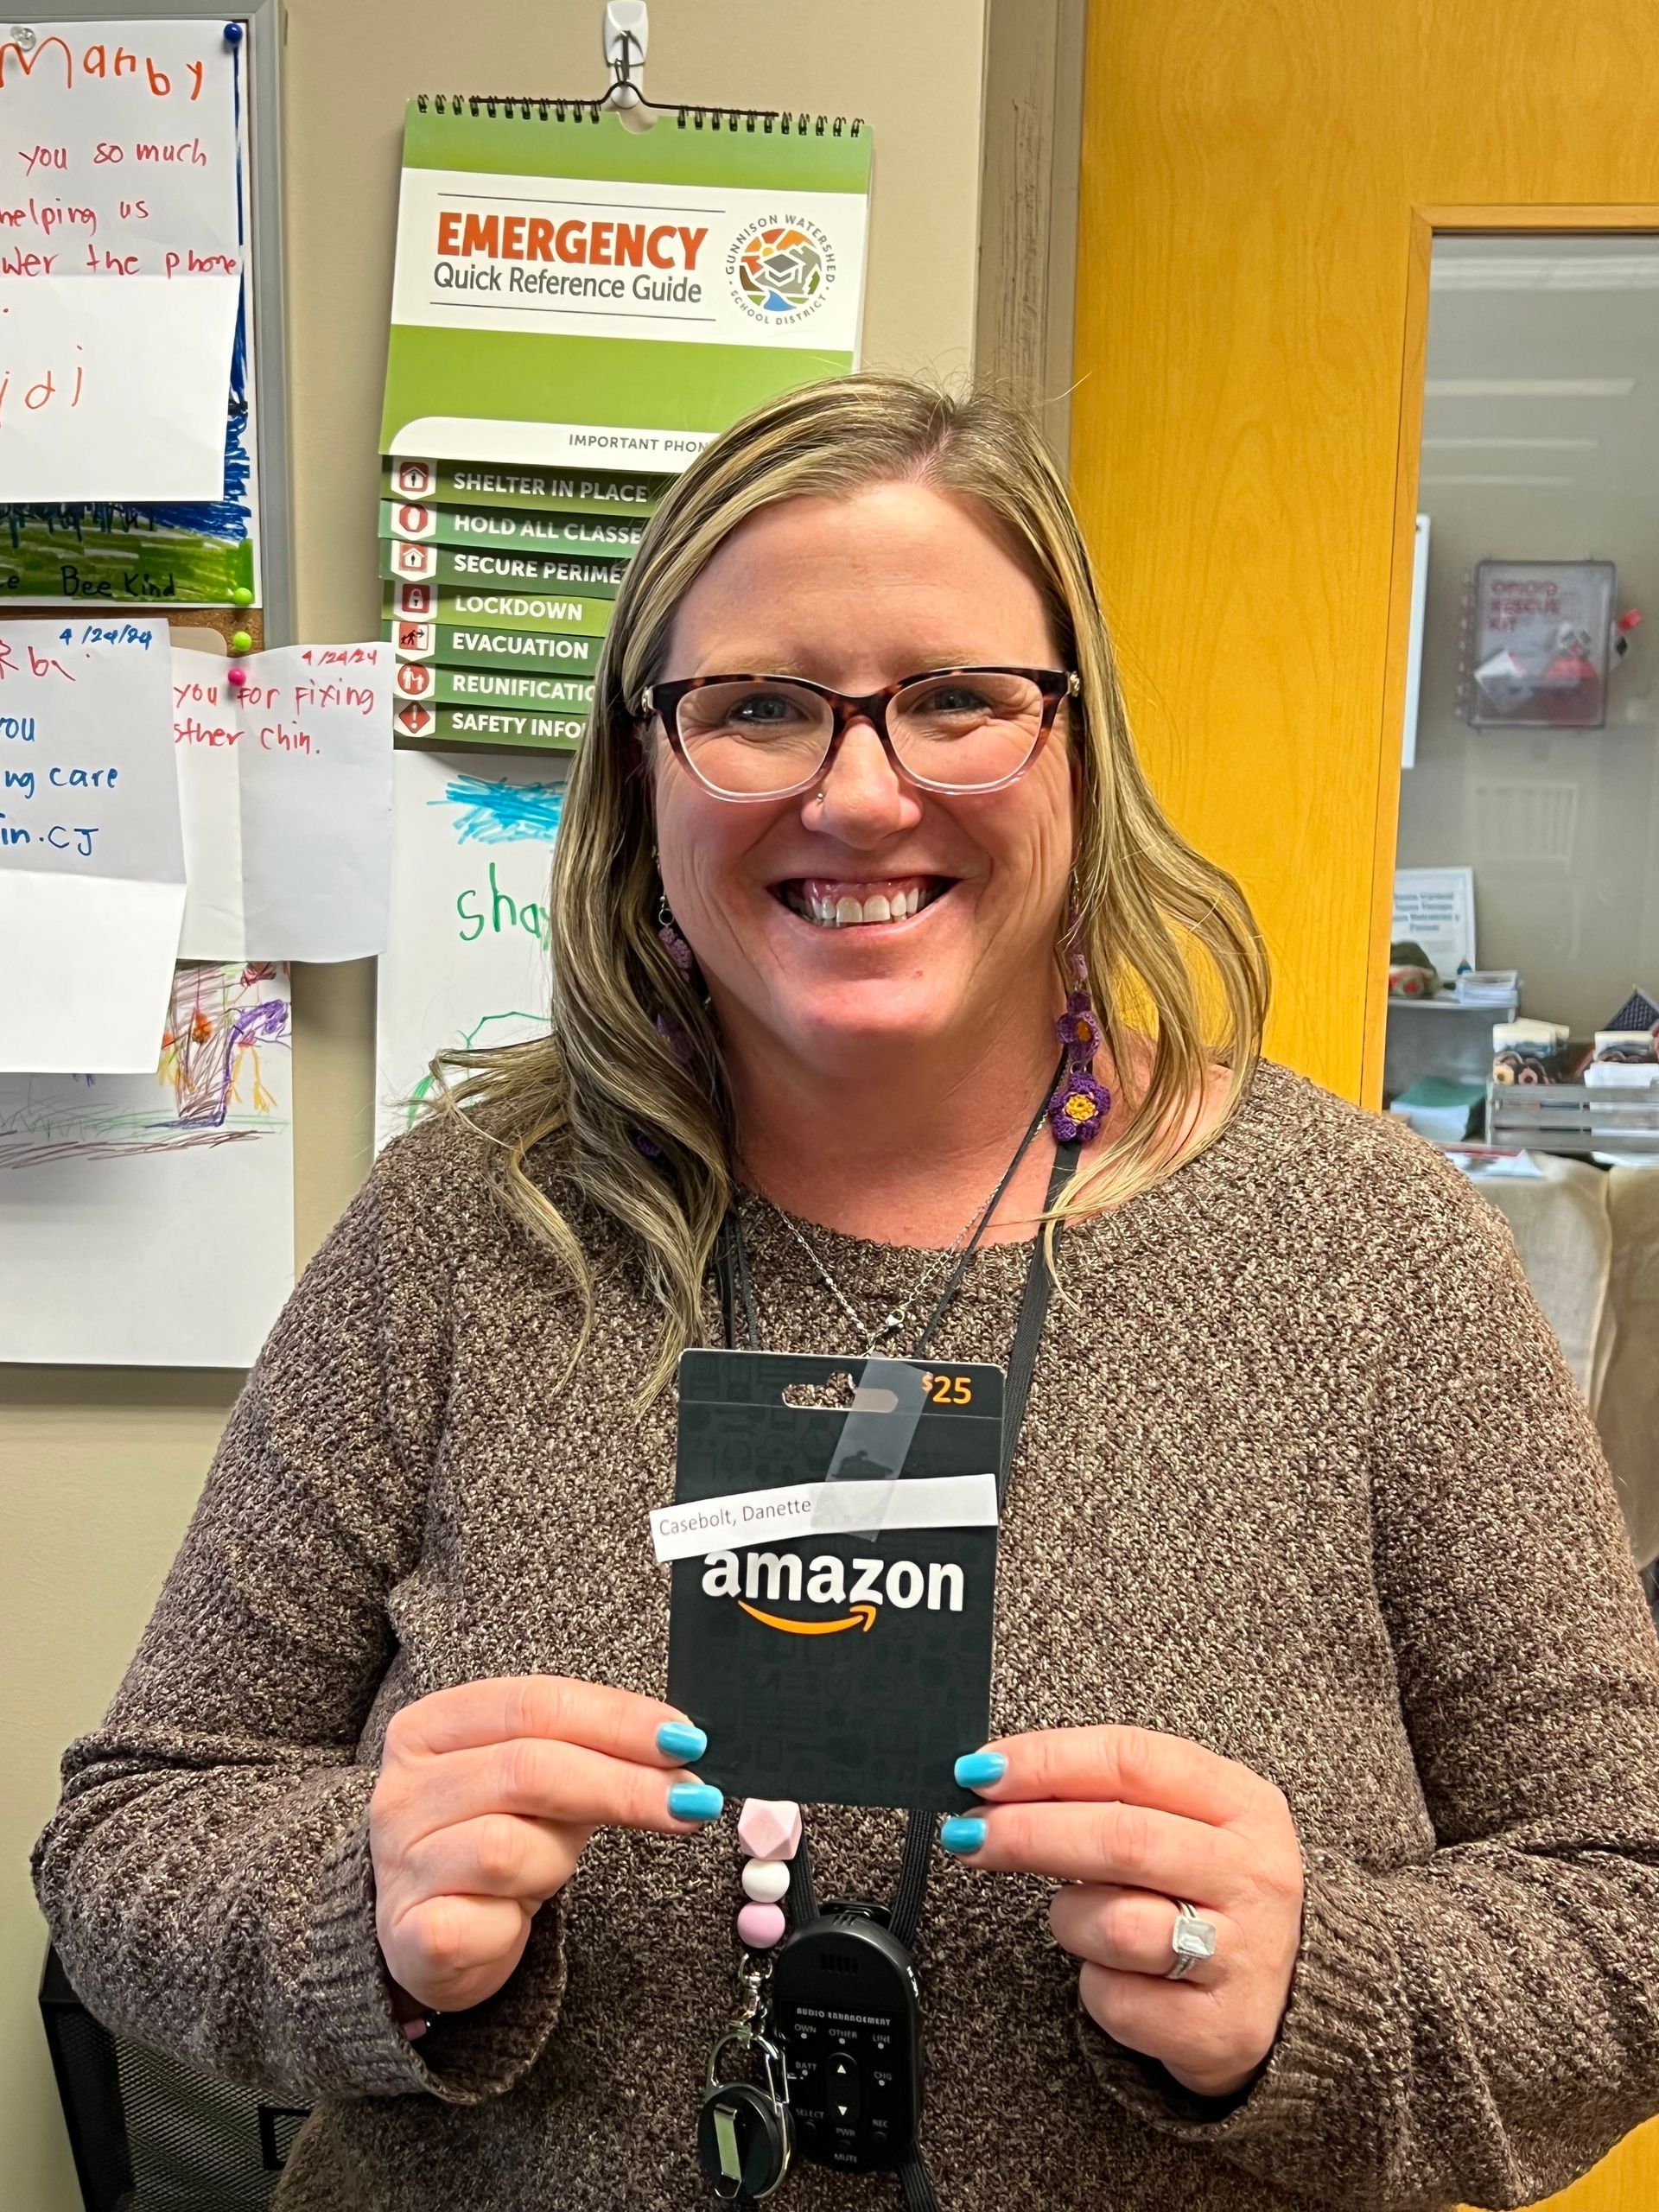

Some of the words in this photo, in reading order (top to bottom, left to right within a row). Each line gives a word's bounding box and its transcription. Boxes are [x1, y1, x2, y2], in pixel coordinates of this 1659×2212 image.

[19, 145, 68, 177] you
[93, 143, 124, 165] so
[137, 138, 207, 167] much
[120, 200, 149, 219] us
[436, 211, 709, 270] EMERGENCY
[725, 214, 779, 276] GUNNISON
[785, 214, 836, 283] WATERSHED
[87, 245, 141, 276] the
[166, 250, 238, 279] phone
[433, 260, 503, 293] Quick
[509, 266, 626, 299] Reference
[632, 273, 702, 304] Guide
[730, 290, 769, 325] SCHOOL
[775, 293, 827, 326] DISTRICT
[569, 434, 660, 451] IMPORTANT
[453, 473, 546, 497] SHELTER
[551, 479, 575, 498] IN
[580, 481, 648, 504] PLACE
[454, 514, 516, 536] HOLD
[520, 519, 560, 540] ALL
[563, 523, 642, 545] CLASSE
[60, 564, 112, 597] Bee
[124, 572, 176, 598] Kind
[454, 555, 538, 579] SECURE
[543, 561, 627, 585] PERIME
[455, 594, 583, 621] LOCKDOWN
[452, 632, 589, 660] EVACUATION
[173, 683, 218, 709] you
[452, 674, 595, 702] REUNIFICATIO
[452, 712, 527, 734] SAFETY
[531, 718, 587, 739] INFO
[49, 767, 119, 788] care
[921, 1372, 973, 1405] $25
[658, 1510, 738, 1537] Casebolt,
[742, 1497, 813, 1523] Danette
[701, 1549, 965, 1612] amazon
[796, 2007, 825, 2018] AUDIO
[794, 2023, 817, 2034] OWN
[829, 2028, 858, 2039] OTHER
[795, 2061, 817, 2071] BATT
[836, 2126, 856, 2137] PWR
[872, 2119, 889, 2128] REC
[834, 2152, 858, 2164] MUTE
